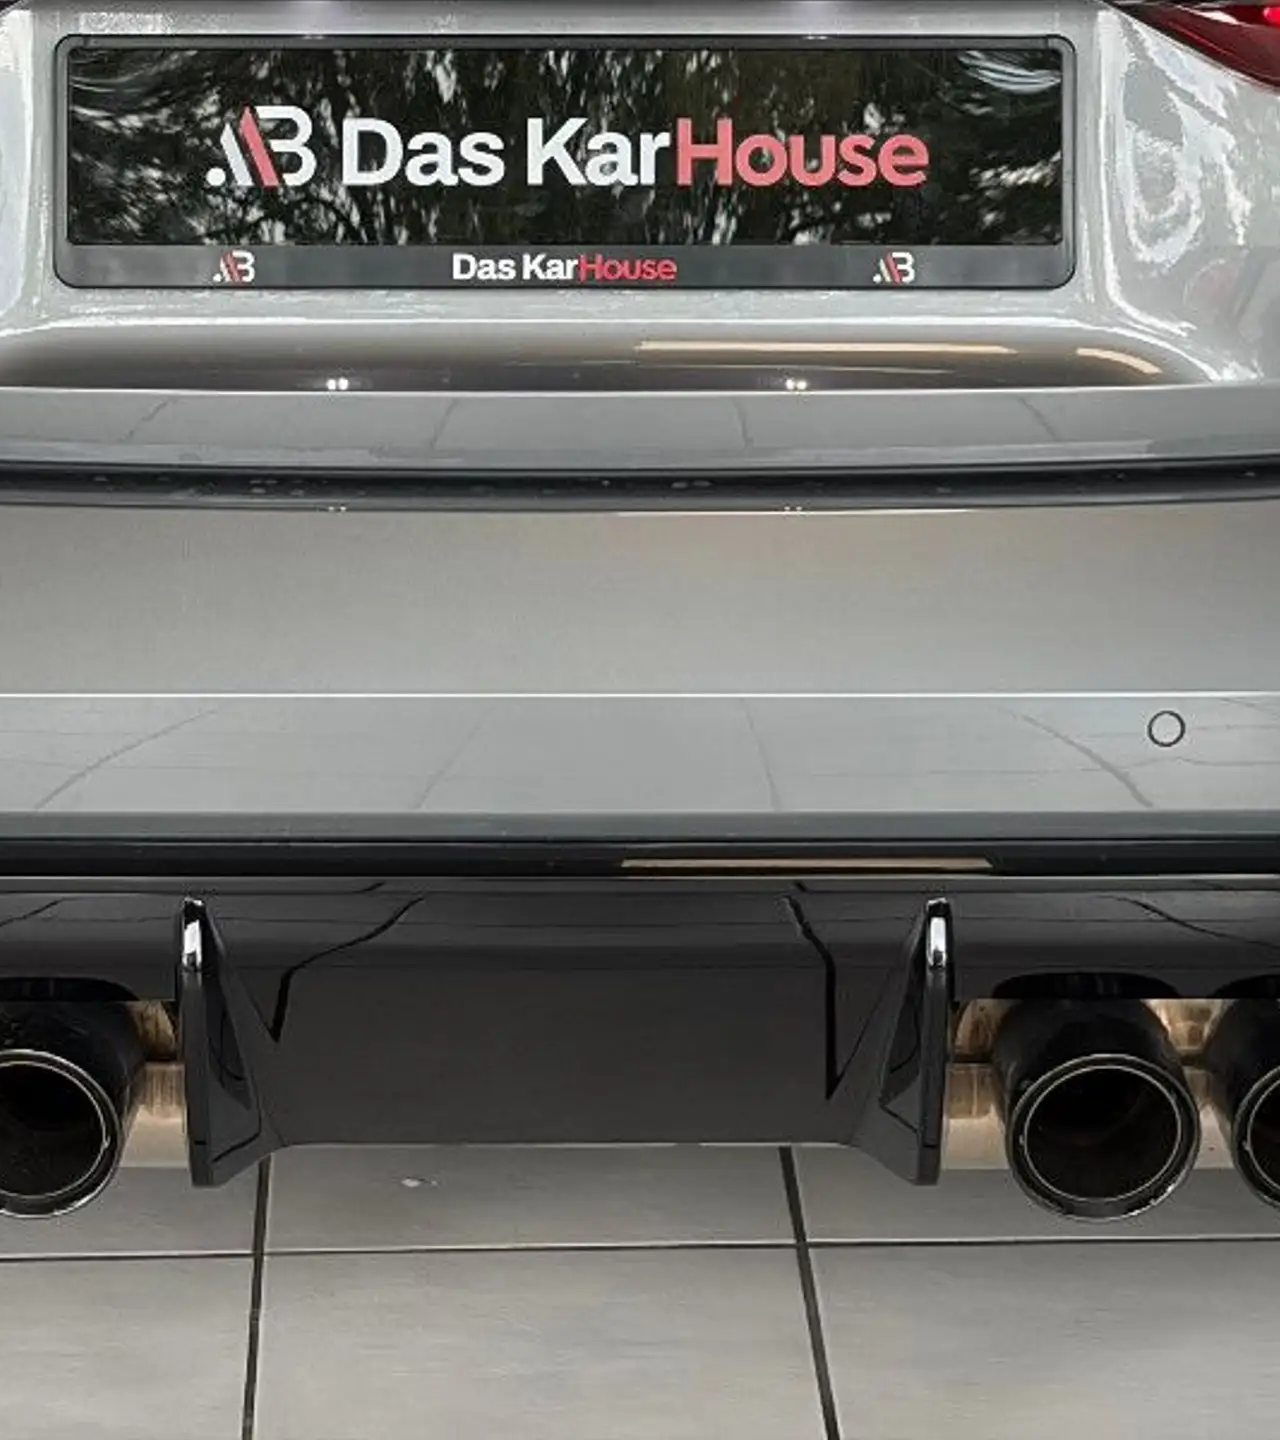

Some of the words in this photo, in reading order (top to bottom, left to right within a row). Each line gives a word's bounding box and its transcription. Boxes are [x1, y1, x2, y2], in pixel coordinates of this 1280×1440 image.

[341, 117, 505, 187] Das
[526, 117, 930, 188] KarHouse
[452, 252, 517, 281] Das
[522, 252, 678, 282] KarHouse
